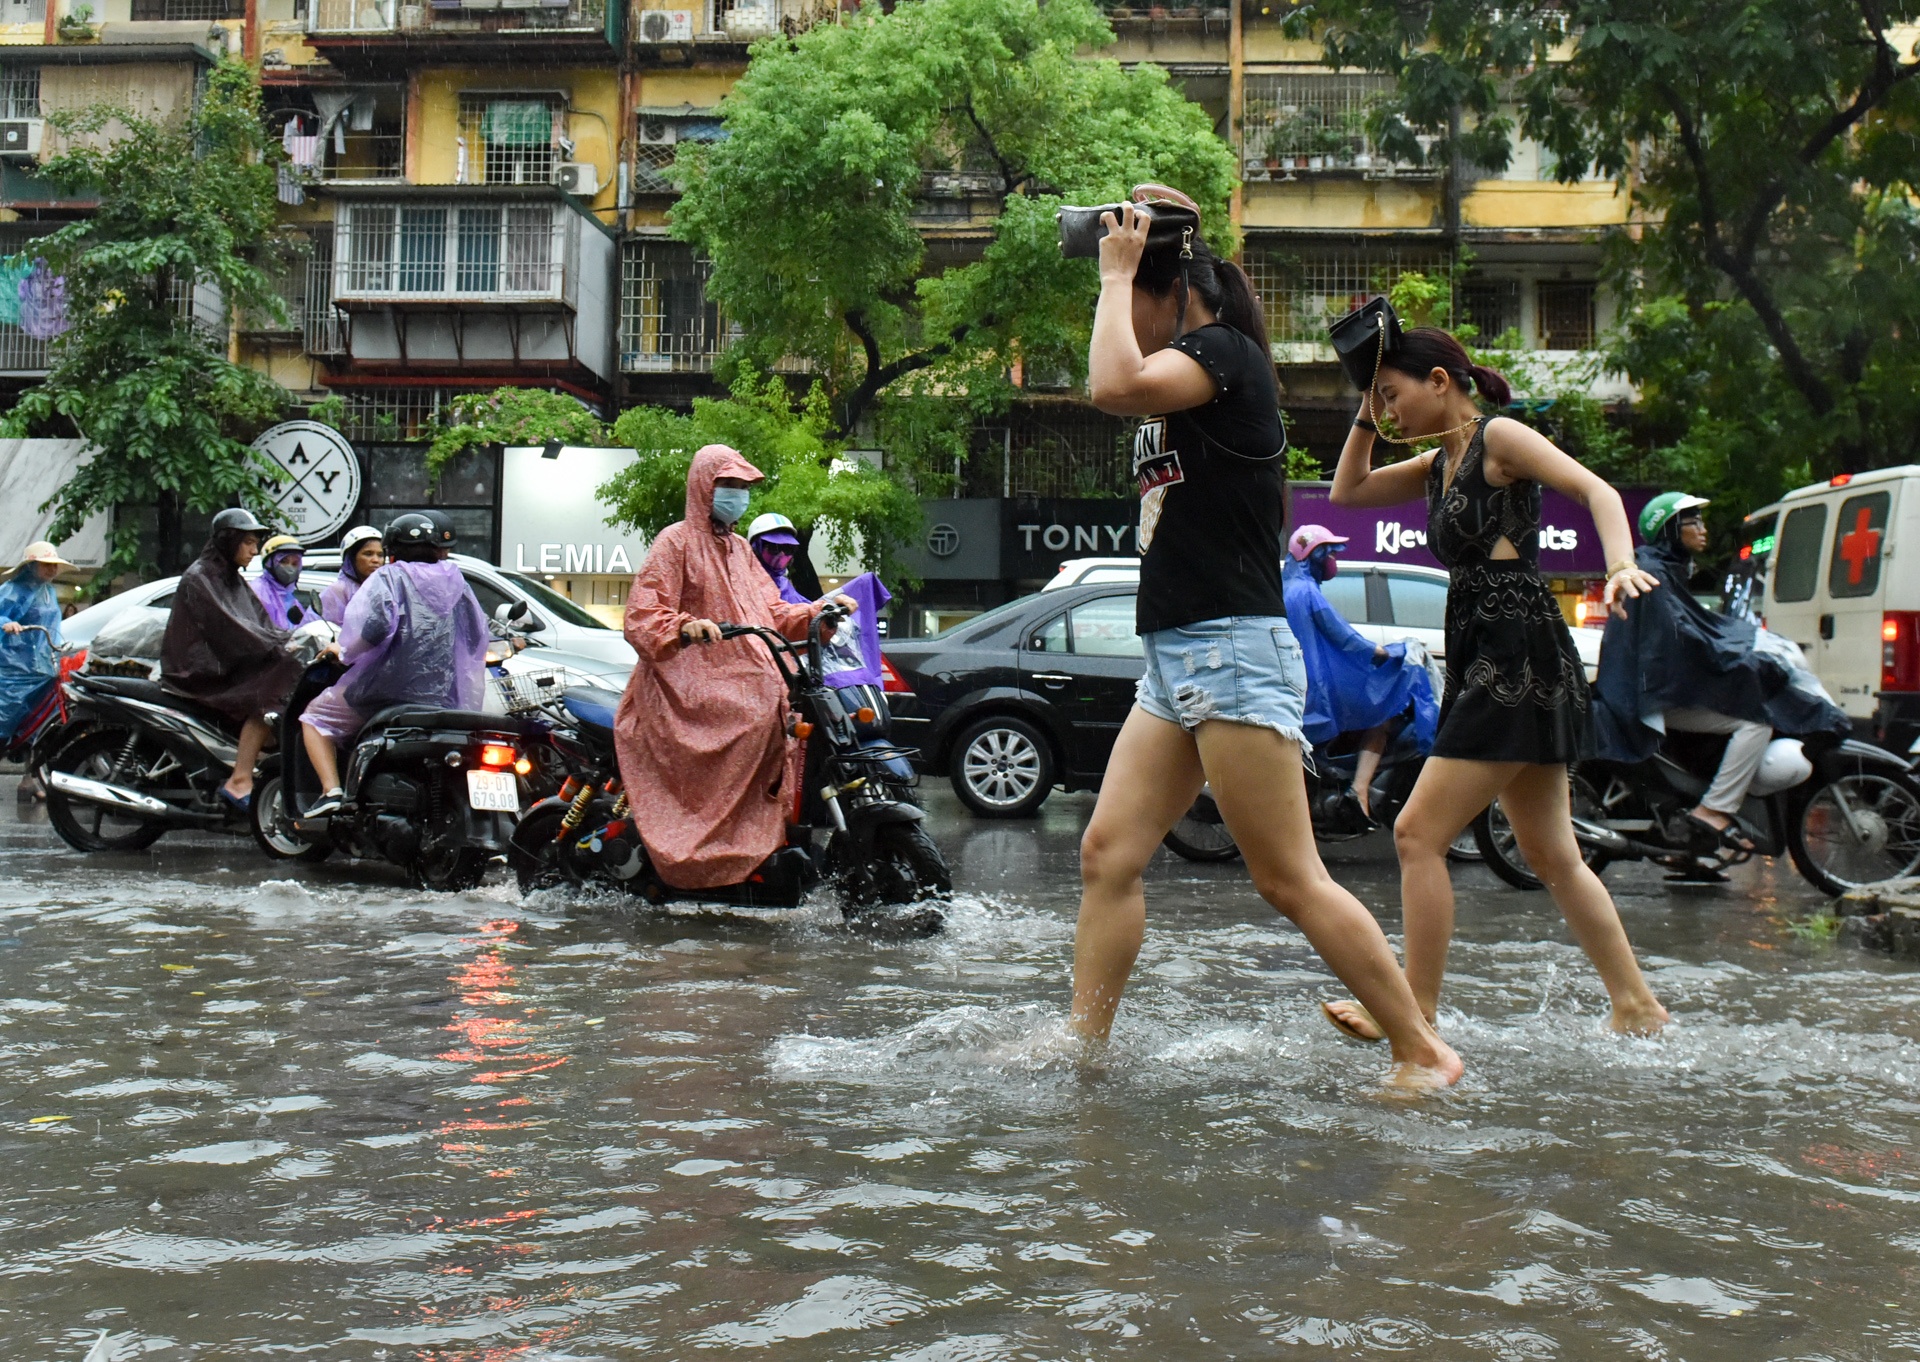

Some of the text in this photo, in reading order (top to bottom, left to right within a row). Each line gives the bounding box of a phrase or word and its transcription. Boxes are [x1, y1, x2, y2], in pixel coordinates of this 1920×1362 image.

[1646, 508, 1666, 531] Grab
[1017, 524, 1140, 552] TONY
[1375, 520, 1427, 554] Klev
[516, 543, 634, 573] LEMIA
[473, 791, 515, 809] 679.08
